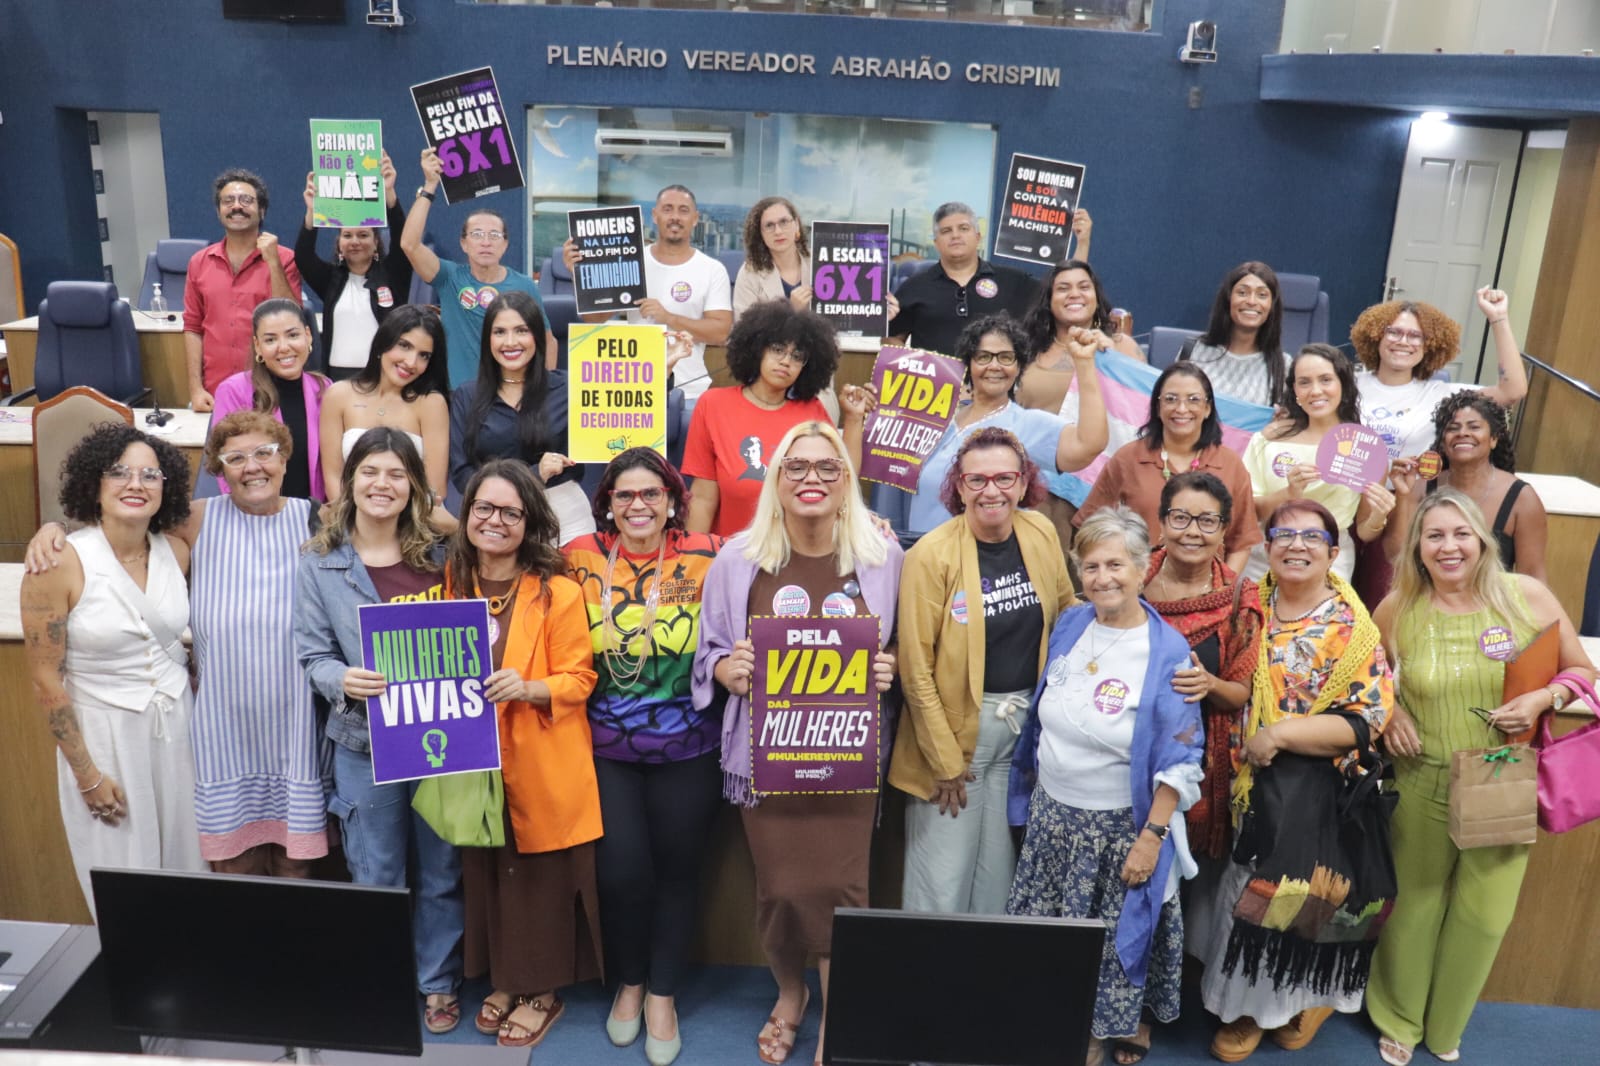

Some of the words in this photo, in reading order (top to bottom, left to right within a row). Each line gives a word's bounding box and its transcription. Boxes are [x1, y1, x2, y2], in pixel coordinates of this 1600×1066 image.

[547, 41, 668, 68] PLENÁRIO
[683, 49, 816, 74] VEREADOR
[831, 55, 951, 81] ABRAHÃO
[965, 63, 1061, 87] CRISPIM
[426, 101, 456, 119] PELO
[456, 95, 477, 110] FIM
[478, 91, 495, 106] DA
[430, 105, 502, 141] ESCALA
[317, 133, 375, 156] CRIANÇA
[438, 127, 512, 178] 6X1
[319, 153, 341, 170] Não
[346, 154, 354, 170] é
[318, 171, 379, 200] MÃE
[1016, 167, 1036, 182] SOU
[1038, 170, 1075, 189] HOMEM
[1013, 191, 1057, 208] CONTRA
[1060, 200, 1069, 209] A
[1025, 183, 1033, 193] E
[1035, 185, 1057, 197] SOU
[1011, 203, 1066, 225] VIOLÊNCIA
[576, 216, 635, 237] HOMENS
[1008, 218, 1063, 236] MACHISTA
[583, 238, 599, 247] NA
[602, 236, 631, 246] LUTA
[579, 249, 603, 258] PELO
[605, 247, 621, 256] FIM
[623, 246, 637, 255] DO
[818, 246, 829, 261] A
[832, 247, 883, 263] ESCALA
[580, 256, 641, 290] FEMINICÍDIO
[814, 264, 882, 302] 6X1
[816, 302, 822, 314] É
[824, 303, 882, 317] EXPLORAÇÃO
[598, 338, 638, 358] PELO
[581, 361, 653, 384] DIREITO
[898, 357, 936, 377] PELA
[581, 390, 599, 407] DE
[605, 390, 653, 407] TODAS
[879, 369, 954, 419] VIDA
[581, 412, 653, 429] DECIDIREM
[995, 572, 1021, 588] MAIS
[660, 594, 696, 604] SINTESE
[999, 594, 1041, 613] POLÍTIC
[787, 629, 842, 646] PELA
[1483, 632, 1508, 646] VIDA
[372, 626, 481, 683] MULHERES
[766, 649, 869, 695] VIDA
[1101, 684, 1126, 699] VIDA
[379, 678, 484, 728] VIVAS
[767, 700, 790, 709] DAS
[759, 711, 872, 748] MULHERES
[767, 752, 863, 762] #MULHERESVIVAS
